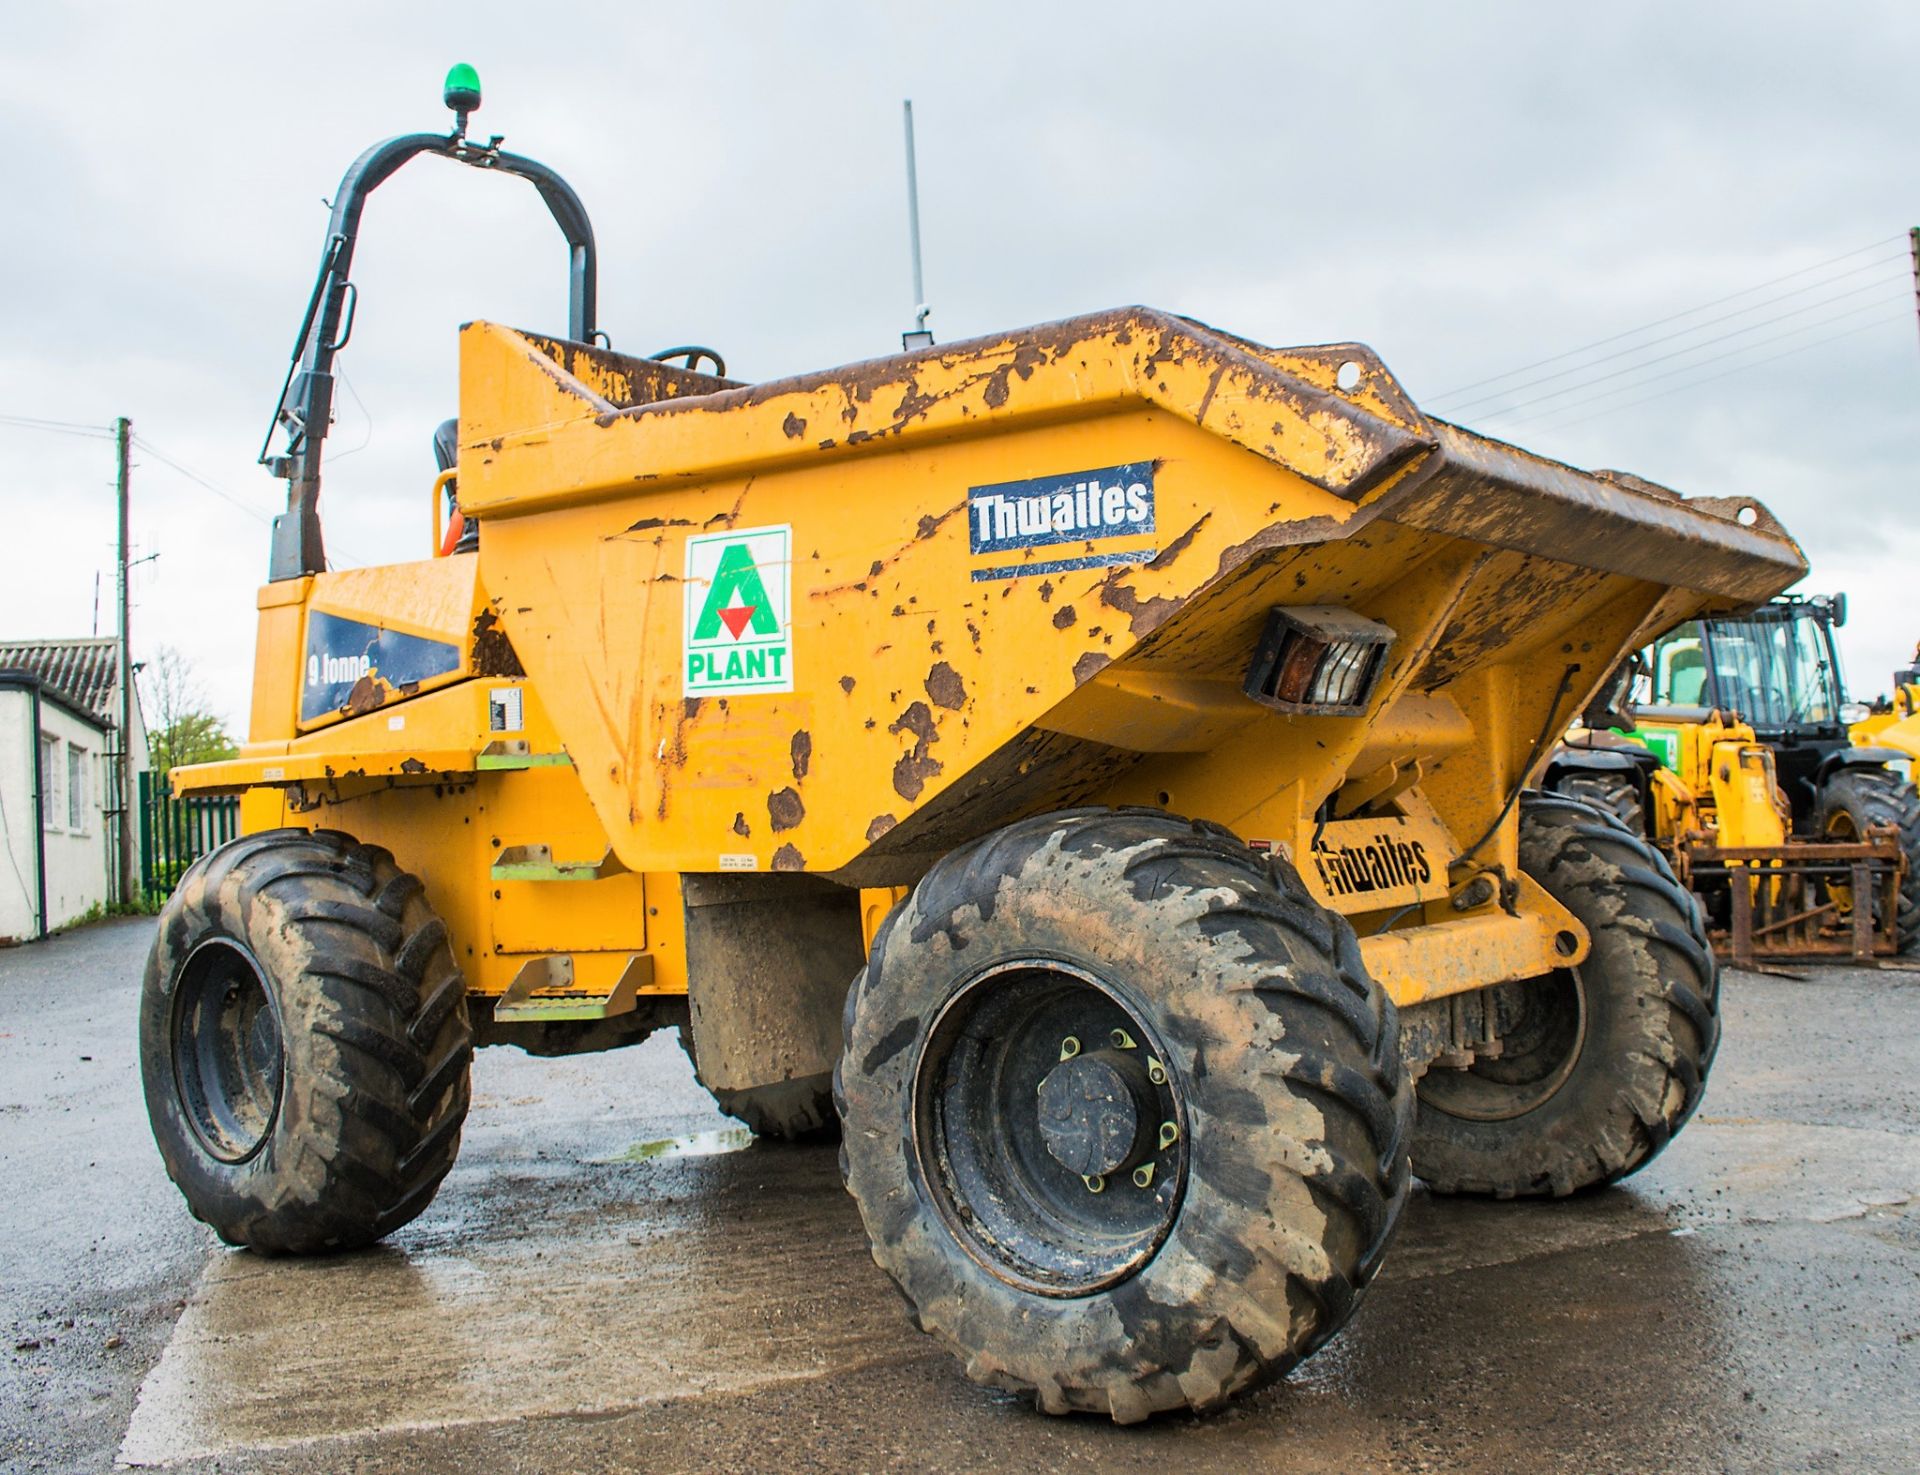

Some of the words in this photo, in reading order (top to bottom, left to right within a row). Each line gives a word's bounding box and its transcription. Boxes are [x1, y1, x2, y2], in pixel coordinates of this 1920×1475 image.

[973, 481, 1149, 541] Thwaites
[693, 544, 781, 640] A
[308, 654, 319, 686] 9
[322, 653, 371, 684] tonne
[688, 647, 786, 682] PLANT
